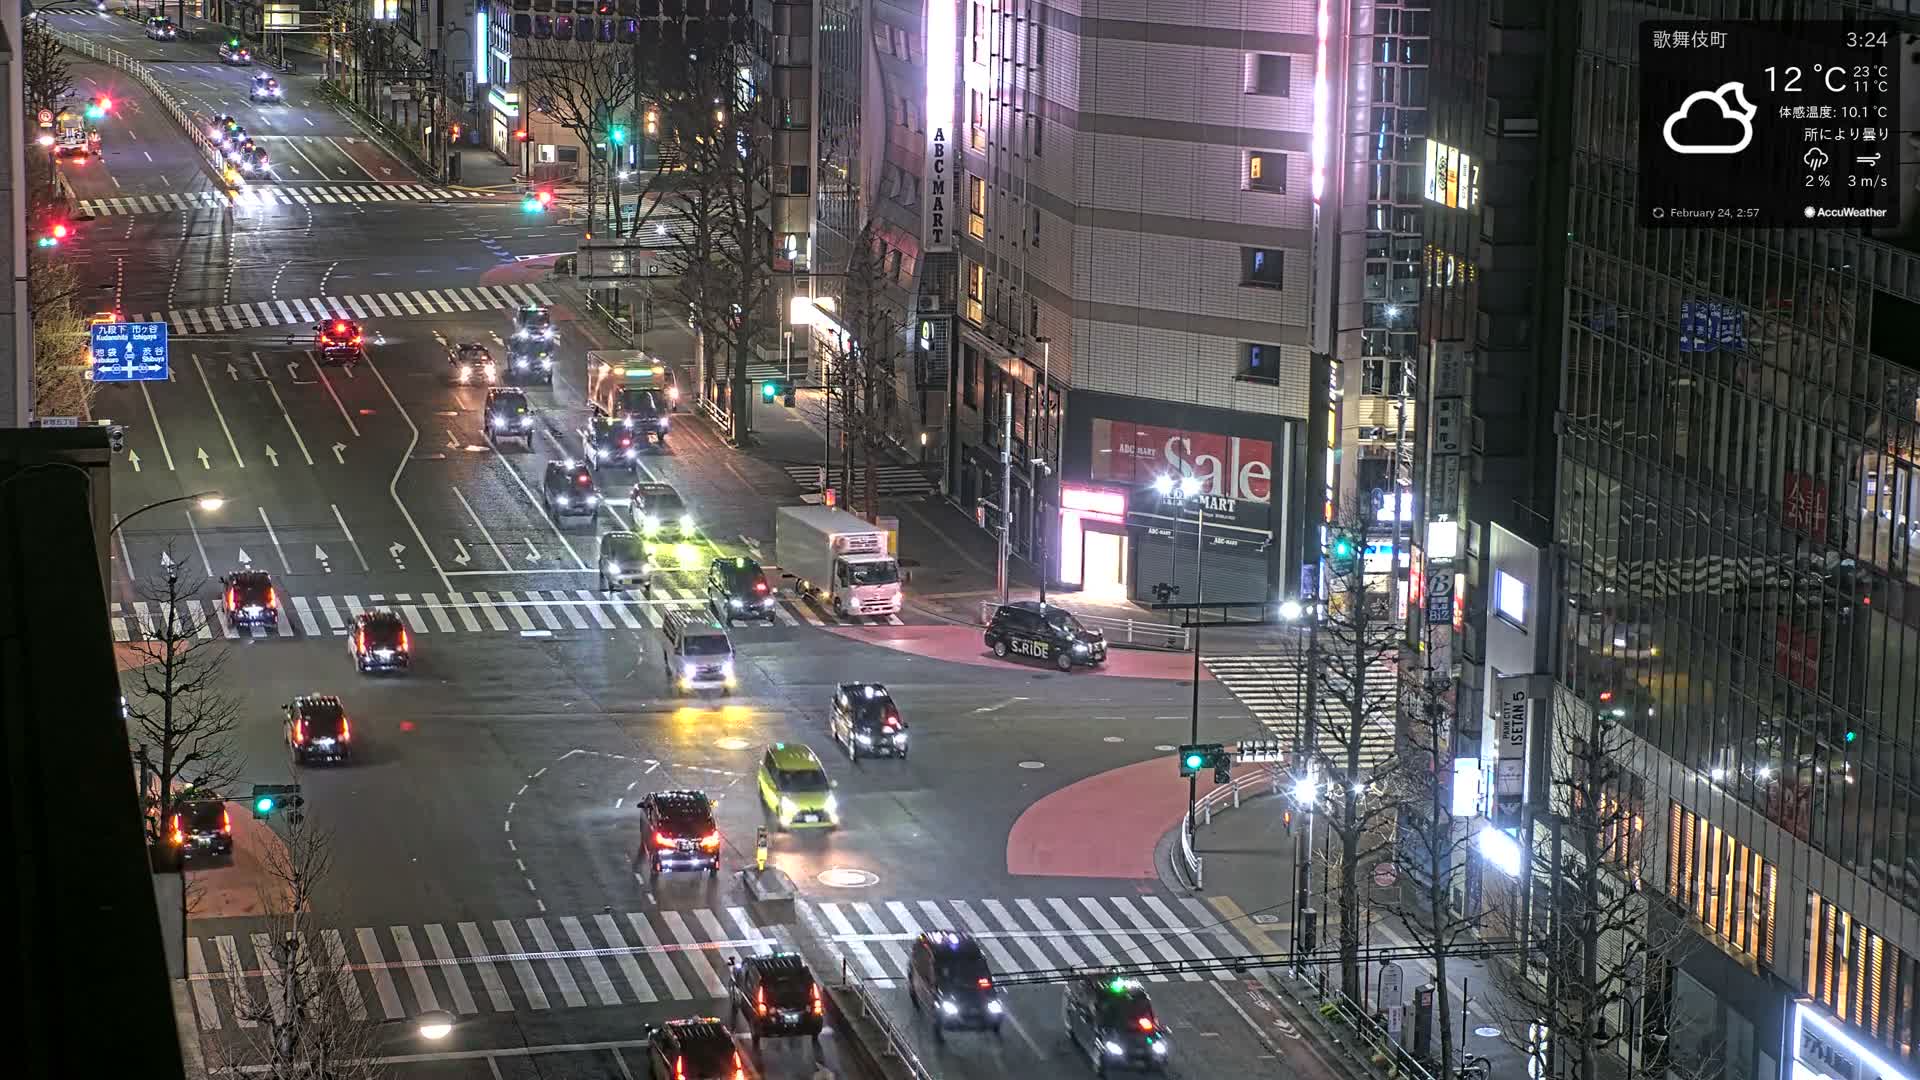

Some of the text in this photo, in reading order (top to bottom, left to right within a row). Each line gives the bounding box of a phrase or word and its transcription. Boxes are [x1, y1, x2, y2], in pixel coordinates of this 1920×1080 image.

[99, 325, 127, 335] 九段下
[1164, 436, 1271, 503] Sale
[1011, 640, 1049, 659] S.RIDE
[1511, 690, 1525, 746] ISETAN 5
